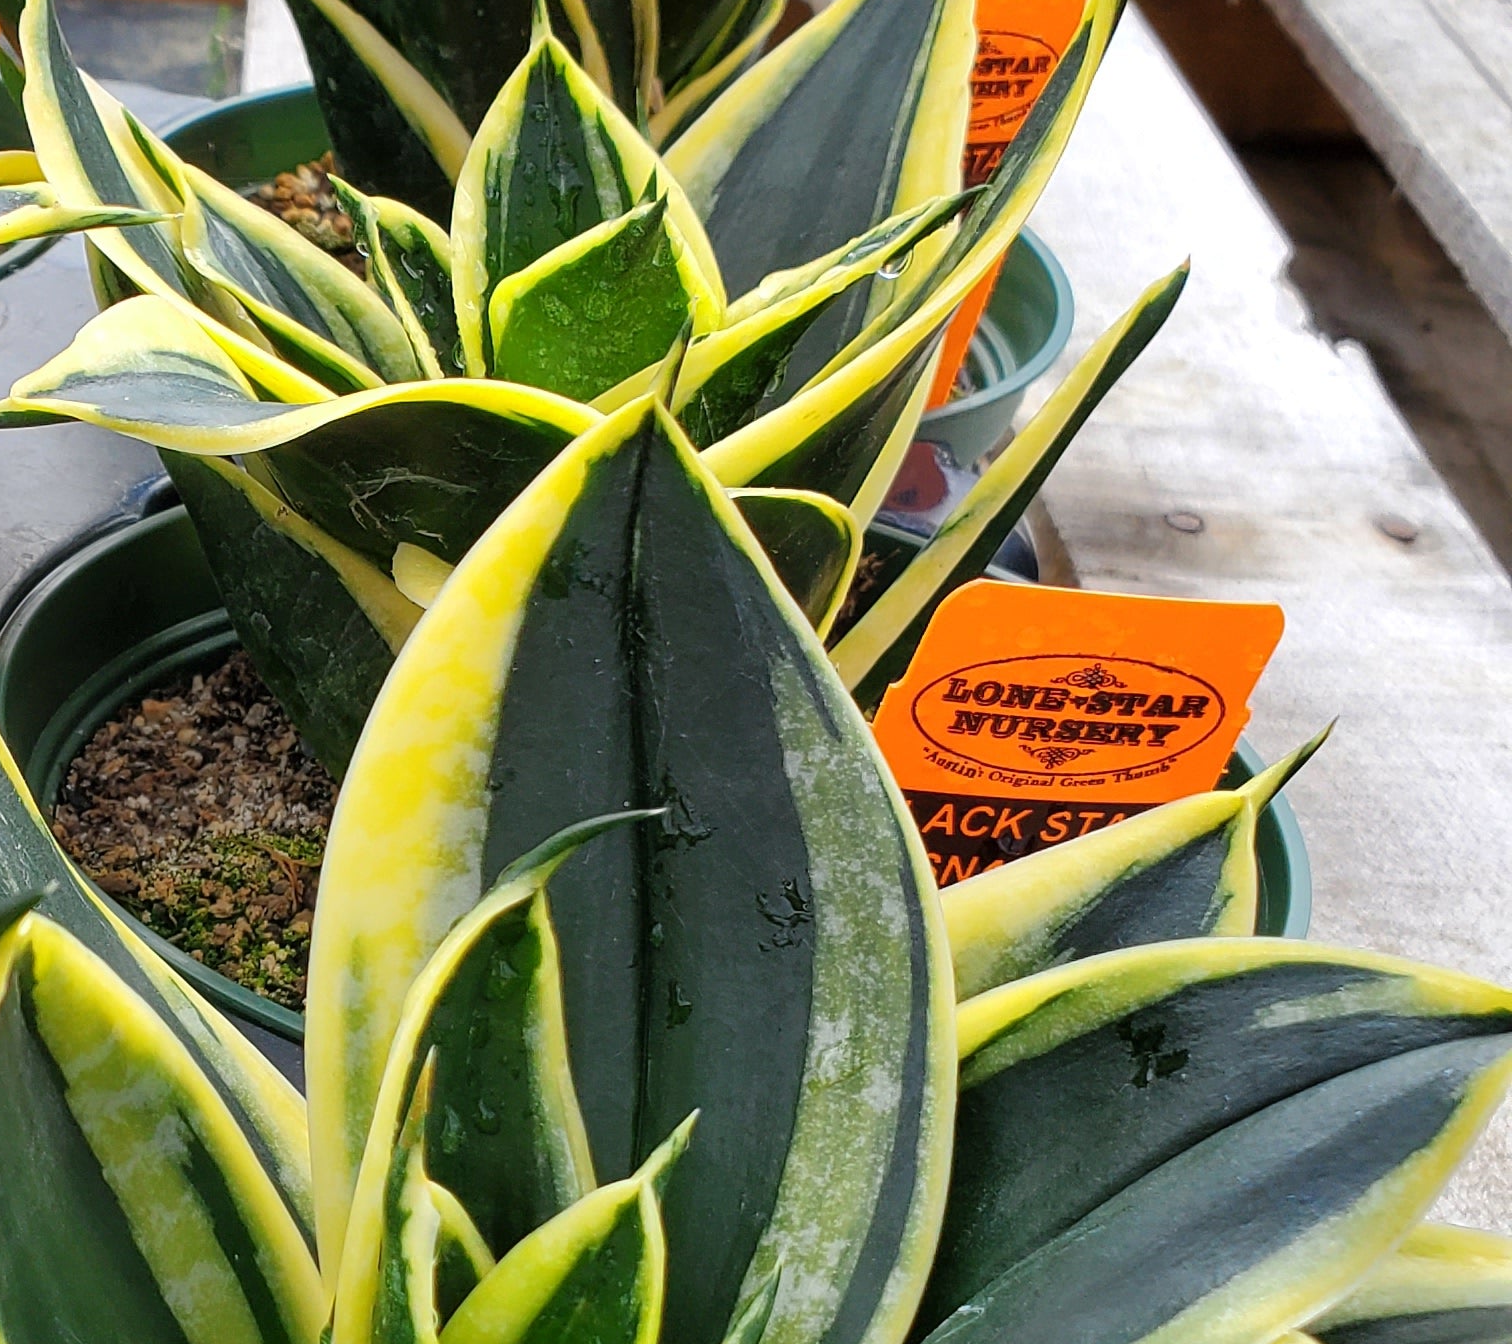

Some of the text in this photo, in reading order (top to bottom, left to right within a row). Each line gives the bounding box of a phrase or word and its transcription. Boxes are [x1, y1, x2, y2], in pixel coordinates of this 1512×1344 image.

[977, 56, 1050, 75] STAR
[942, 677, 1210, 719] LONE STAR
[947, 709, 1180, 747] NURSERY
[988, 769, 1055, 788] Original
[1060, 776, 1105, 788] Green
[908, 799, 1128, 843] ACK ST
